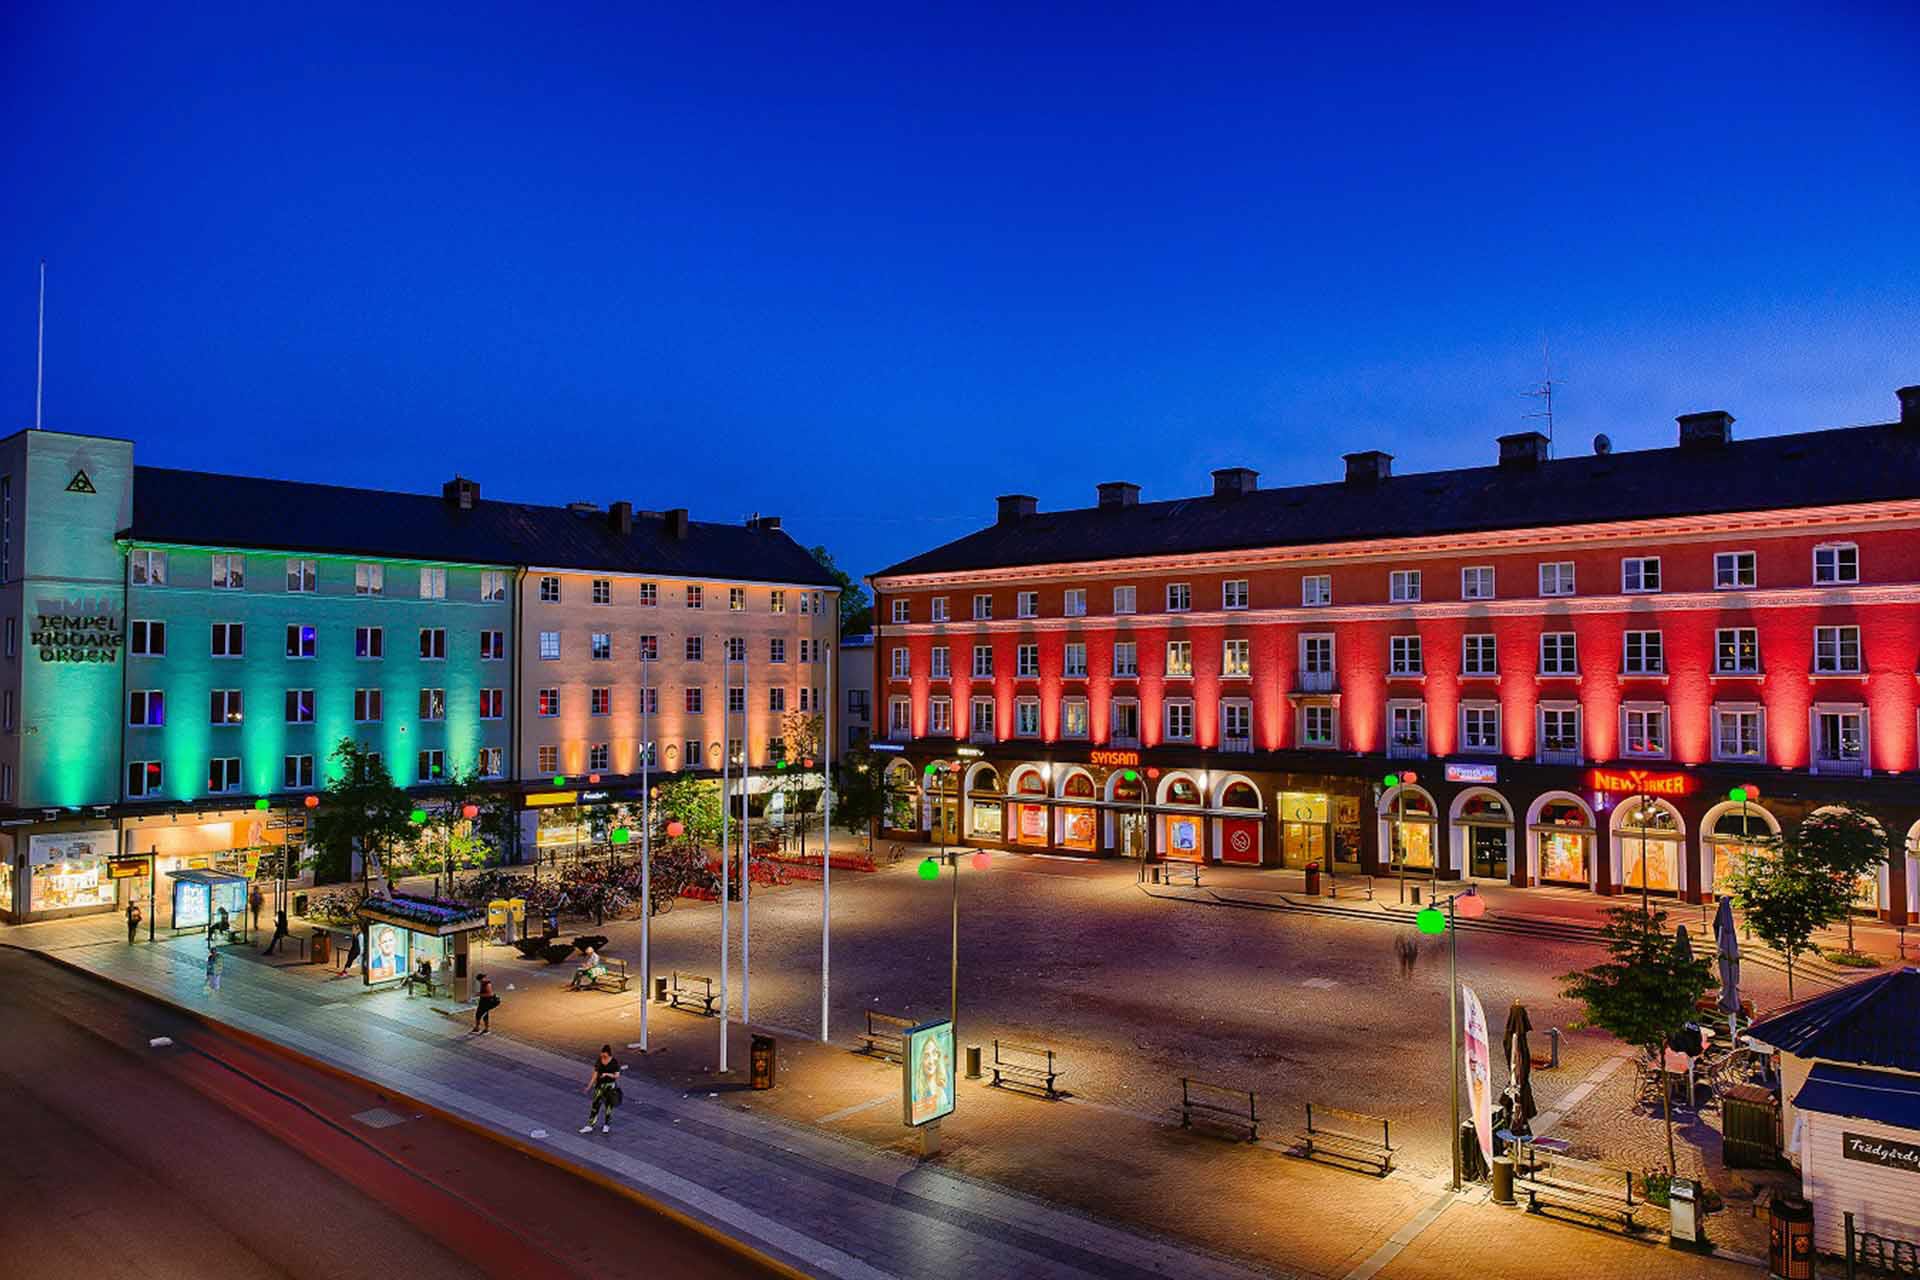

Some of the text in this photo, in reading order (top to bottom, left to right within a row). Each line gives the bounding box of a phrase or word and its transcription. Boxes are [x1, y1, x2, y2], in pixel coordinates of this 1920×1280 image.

[37, 615, 118, 631] TEMPEL
[31, 631, 124, 647] RIDDARE
[40, 648, 116, 663] ORDEN
[1090, 751, 1139, 766] SYNSAM
